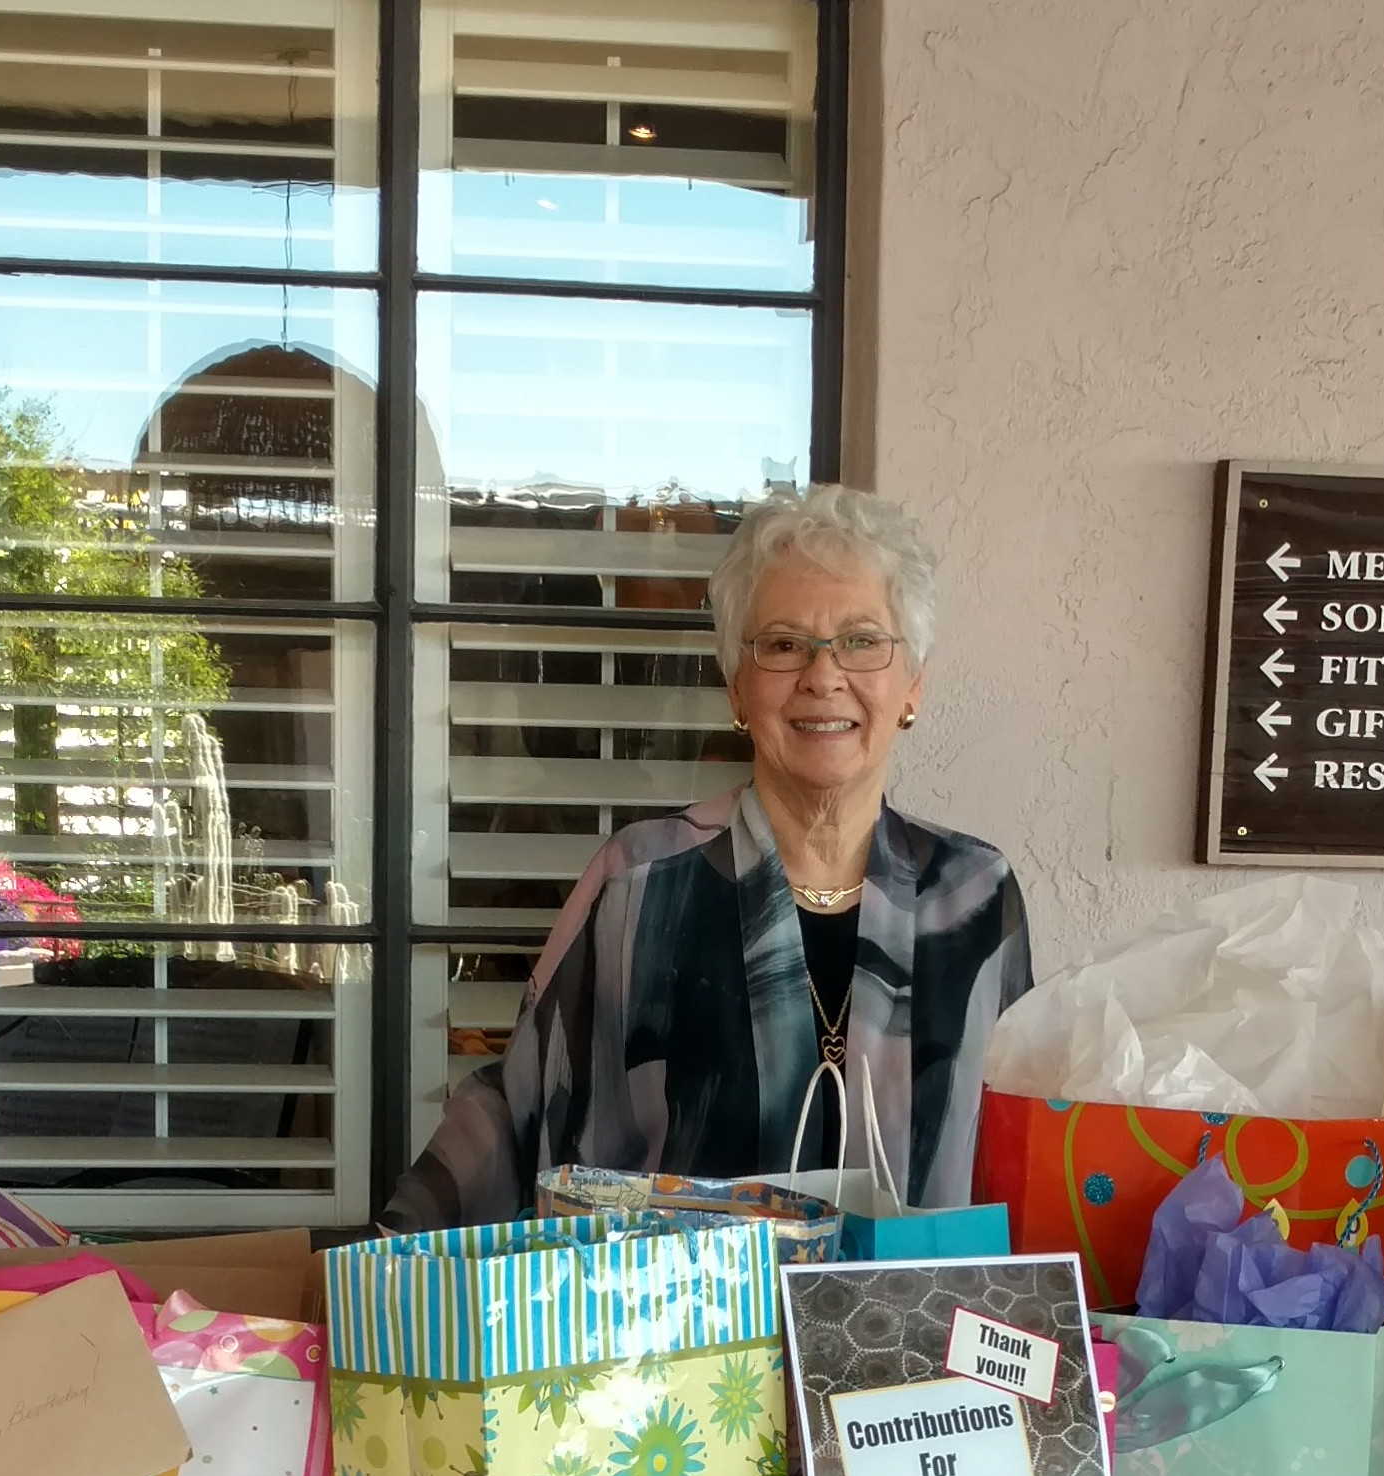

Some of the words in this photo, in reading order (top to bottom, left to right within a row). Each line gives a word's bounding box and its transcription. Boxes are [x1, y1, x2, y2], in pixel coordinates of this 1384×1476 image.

[978, 1322, 1033, 1361] Thank
[976, 1355, 1027, 1388] you!!!
[846, 1403, 1015, 1450] Contributions
